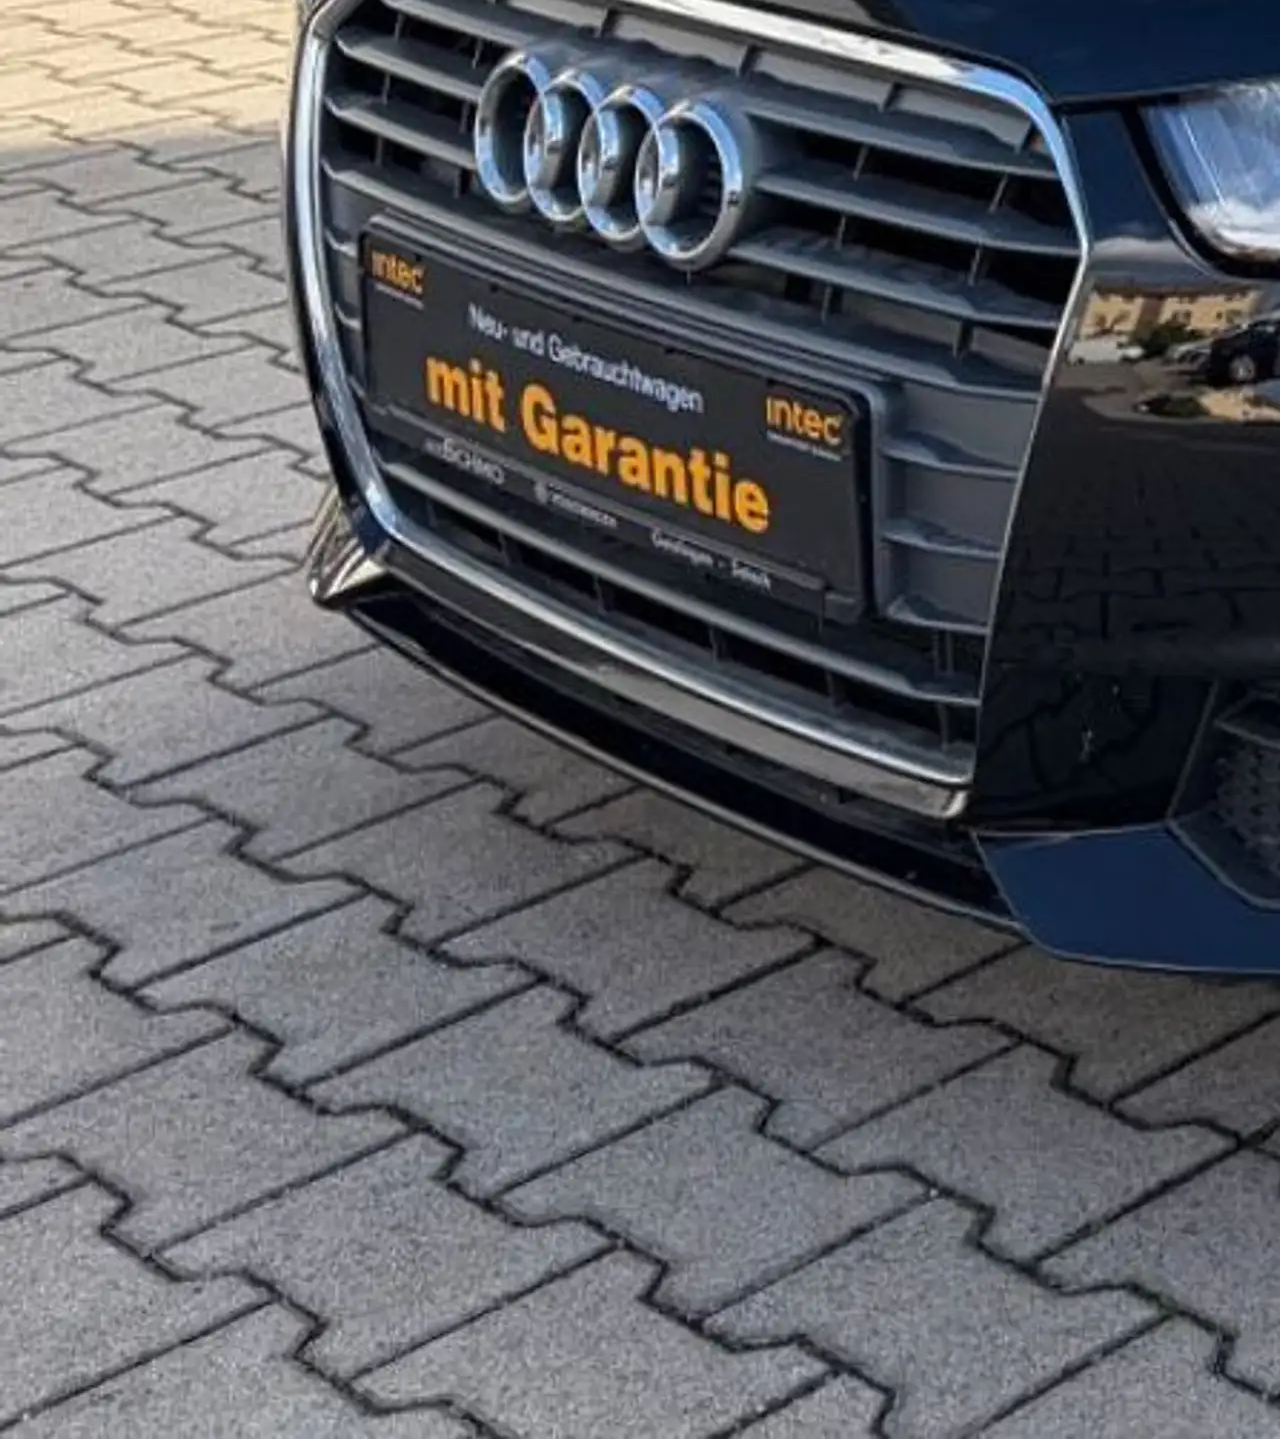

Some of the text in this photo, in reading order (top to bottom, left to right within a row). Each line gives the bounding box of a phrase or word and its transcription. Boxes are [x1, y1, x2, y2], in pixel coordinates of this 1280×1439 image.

[371, 249, 426, 295] intec
[468, 302, 705, 414] Neu- und Gebrauchtwagen
[425, 356, 507, 433] mit
[520, 382, 771, 535] Garantie
[766, 395, 843, 446] intec
